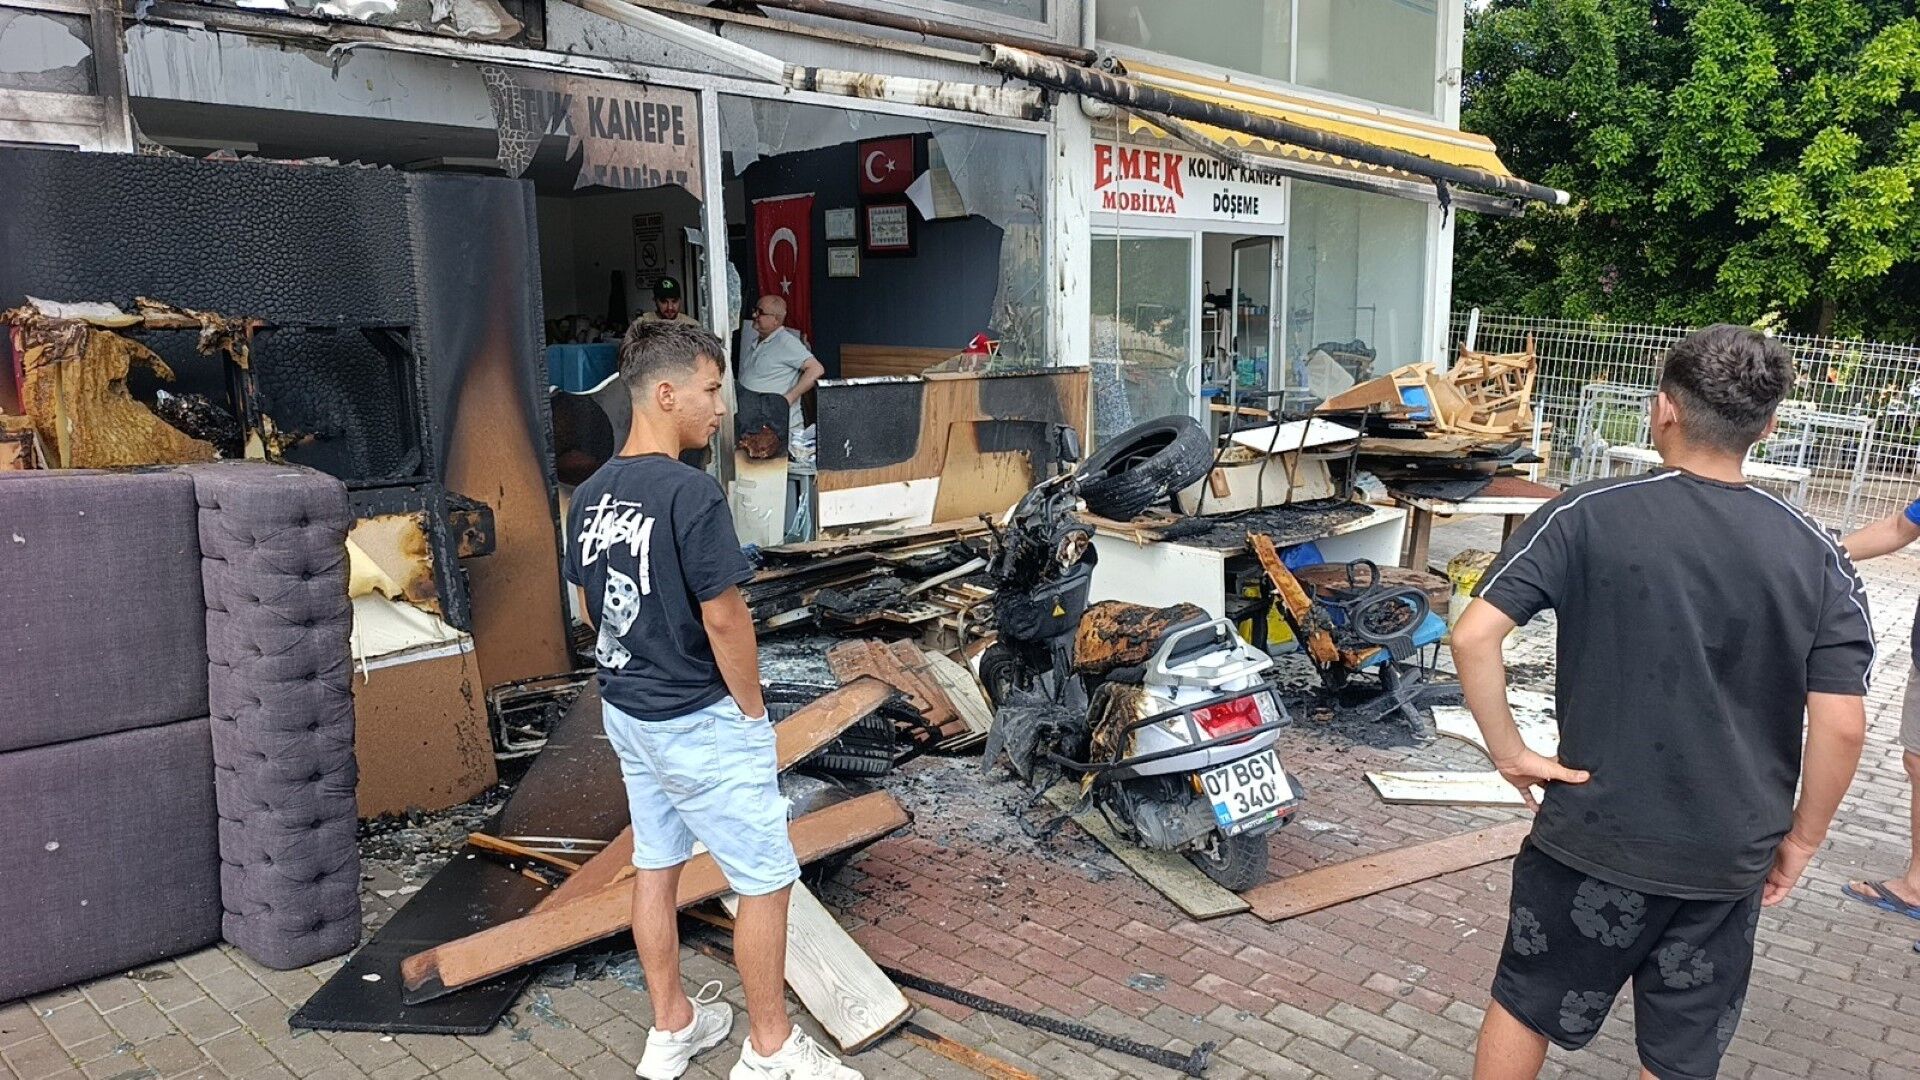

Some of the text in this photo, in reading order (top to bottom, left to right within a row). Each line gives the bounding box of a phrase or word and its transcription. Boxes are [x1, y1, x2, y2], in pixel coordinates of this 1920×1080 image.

[587, 95, 686, 146] KANEPE
[1094, 144, 1184, 199] EMEK
[1102, 188, 1177, 214] MOBİLYA
[1213, 187, 1259, 219] DÖŞEME
[1205, 752, 1277, 796] 07 BGY
[1233, 782, 1275, 813] 340
